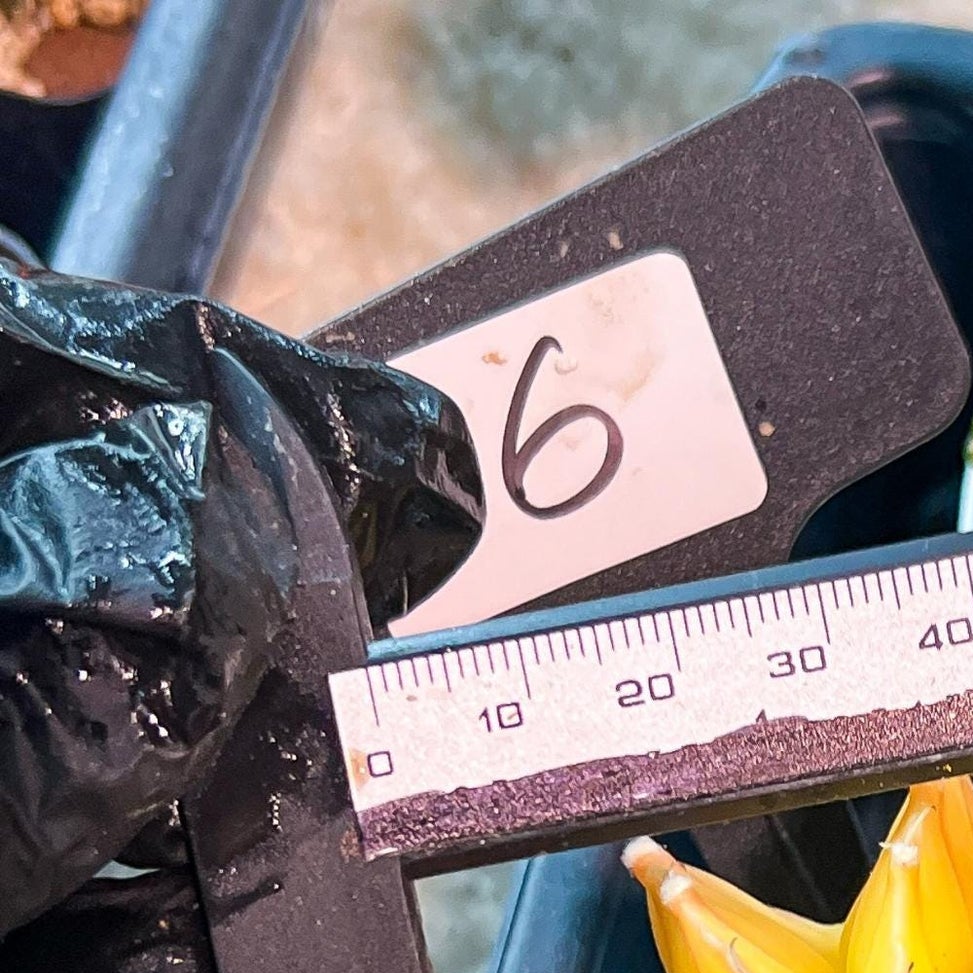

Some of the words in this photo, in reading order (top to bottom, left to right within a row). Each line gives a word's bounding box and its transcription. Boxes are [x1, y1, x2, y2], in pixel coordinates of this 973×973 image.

[502, 336, 624, 520] 6
[367, 751, 394, 778] 0
[478, 702, 523, 733] 10
[616, 673, 675, 707] 20
[767, 645, 827, 679] 30
[919, 617, 973, 652] 40
